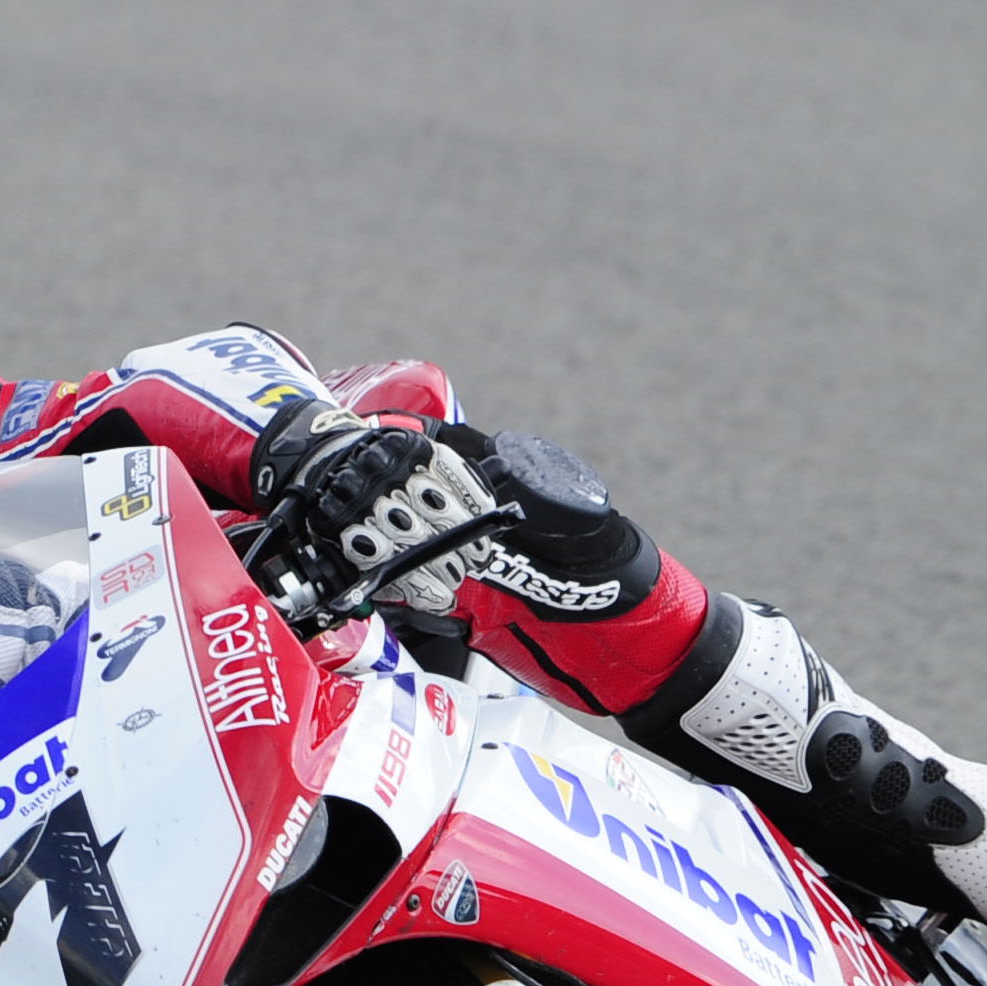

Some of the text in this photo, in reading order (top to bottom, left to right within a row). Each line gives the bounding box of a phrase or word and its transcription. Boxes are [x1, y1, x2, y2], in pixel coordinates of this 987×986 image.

[202, 604, 277, 733] Althea
[374, 728, 412, 808] 1198
[256, 795, 313, 892] DUCATI
[437, 867, 463, 909] DUCATI
[503, 741, 816, 984] Unibat
